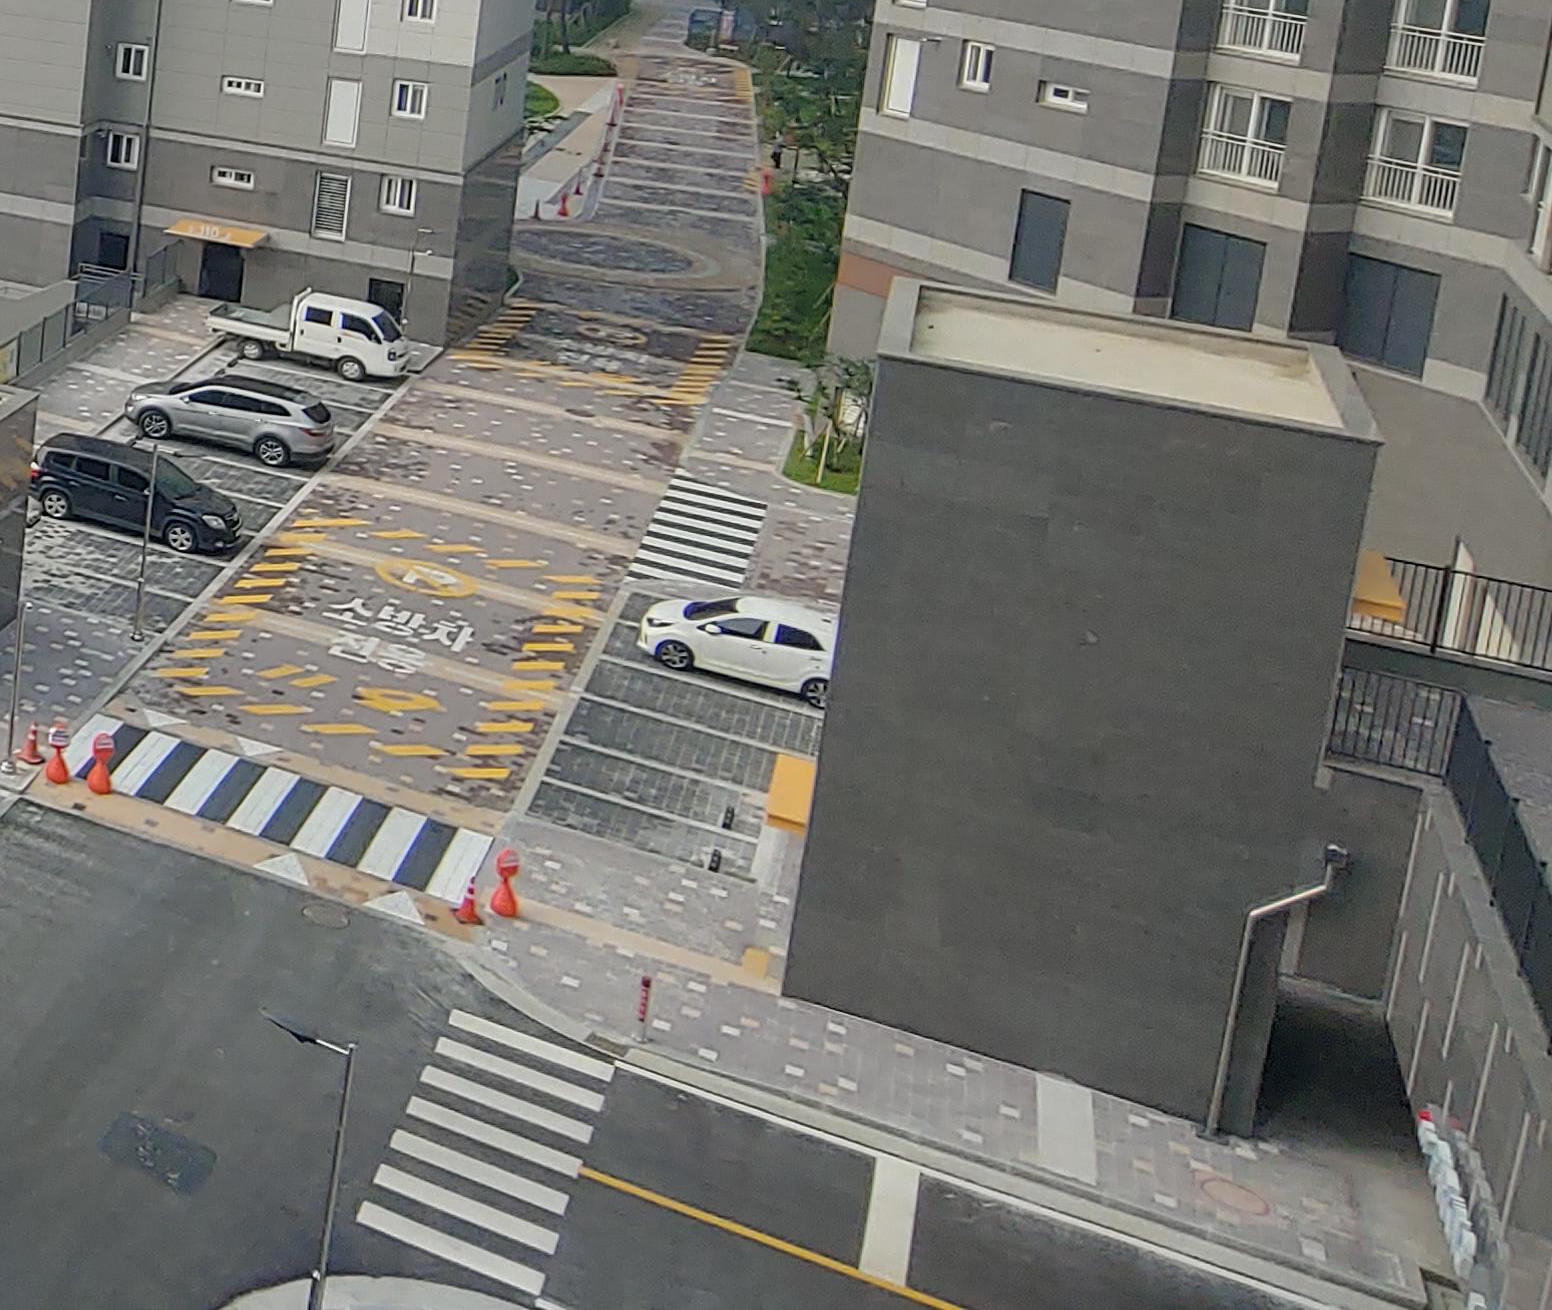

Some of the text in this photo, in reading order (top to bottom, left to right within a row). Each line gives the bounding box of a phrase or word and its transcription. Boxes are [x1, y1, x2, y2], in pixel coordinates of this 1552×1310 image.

[200, 225, 219, 237] 110
[322, 597, 475, 653] 소방차
[328, 630, 427, 674] 전용
